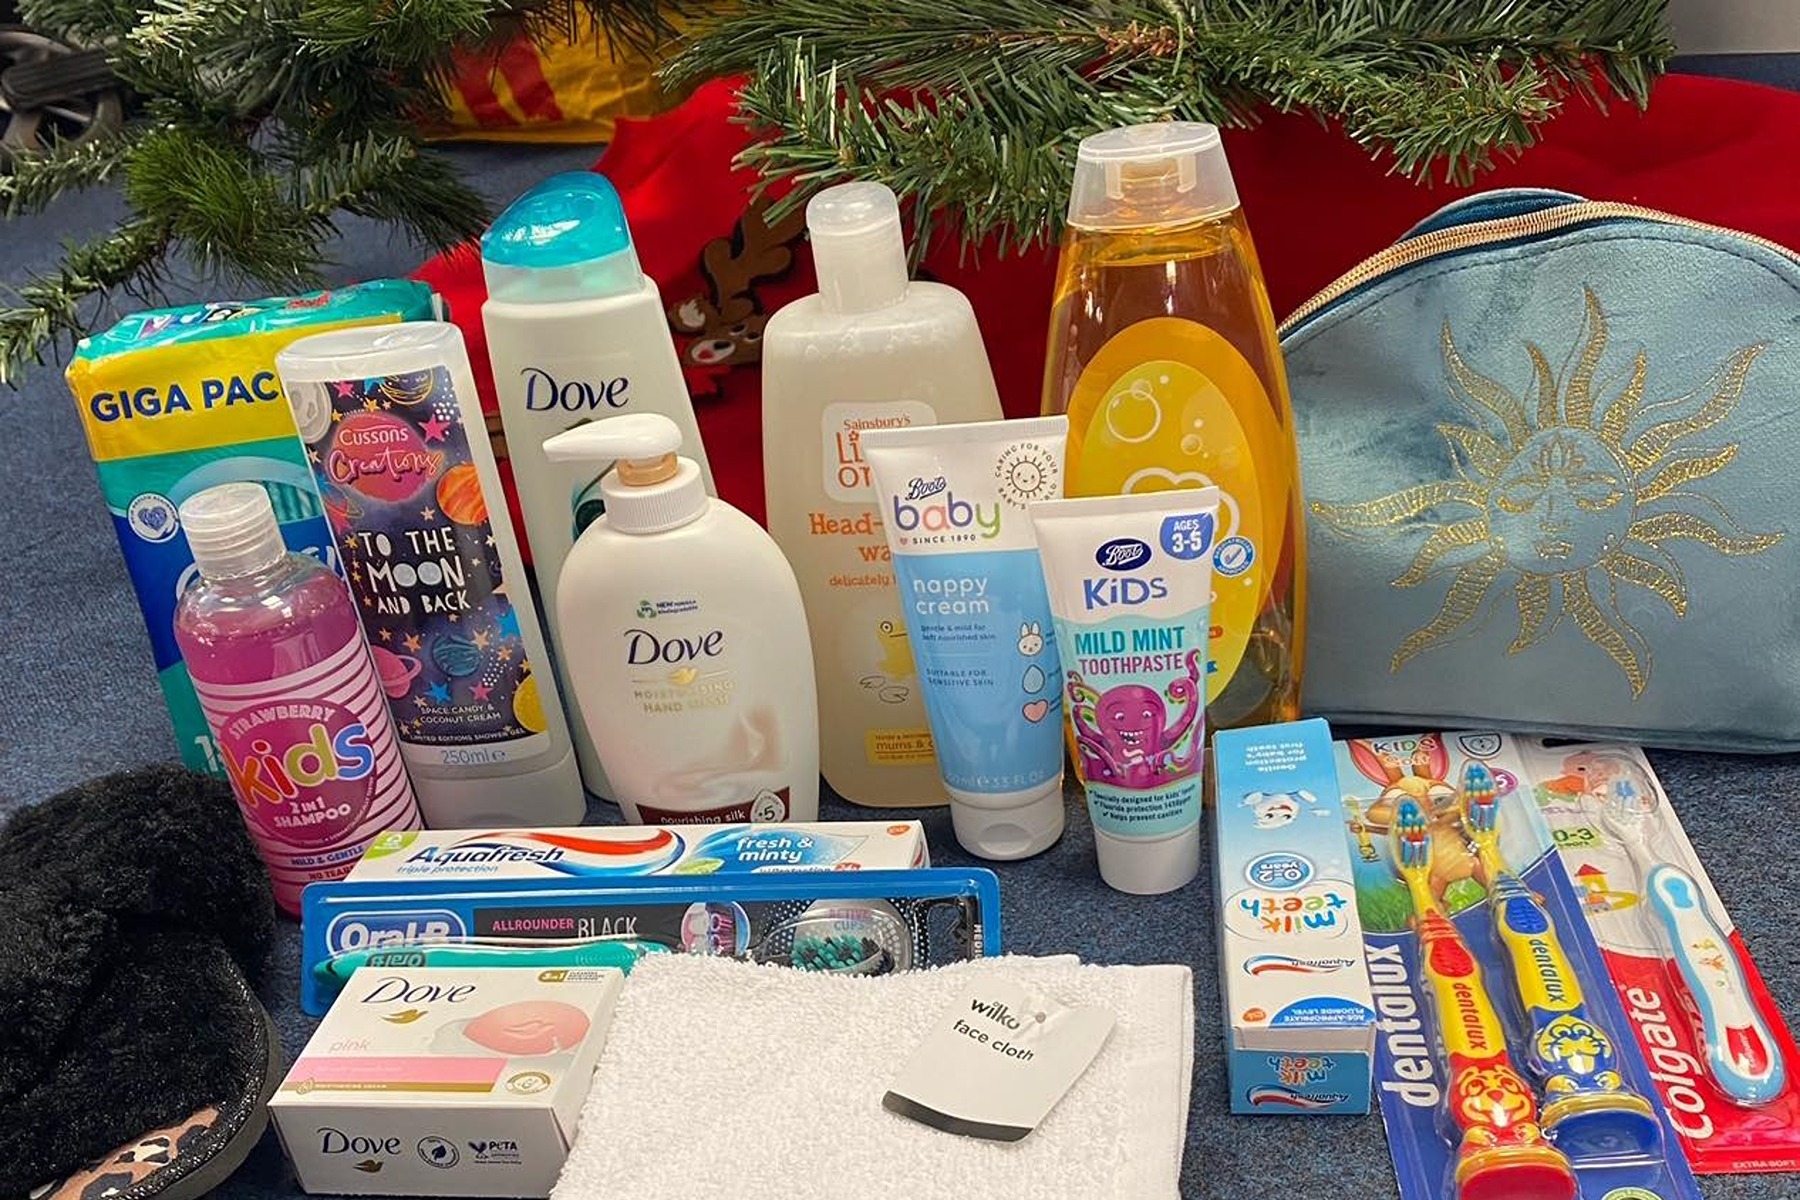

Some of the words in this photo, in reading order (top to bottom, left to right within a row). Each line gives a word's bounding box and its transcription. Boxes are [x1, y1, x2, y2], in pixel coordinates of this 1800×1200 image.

[90, 384, 192, 422] GIGA
[202, 371, 286, 409] PAC
[520, 367, 629, 411] Dove
[843, 413, 911, 431] Sainsbury's
[339, 426, 409, 446] Cussons
[329, 446, 445, 483] Creations
[994, 444, 1017, 478] CARING
[1020, 443, 1039, 451] FOR
[1042, 449, 1058, 474] YOUR
[905, 476, 947, 501] Boots
[808, 512, 883, 535] Head-
[893, 490, 1001, 539] baby
[1173, 519, 1200, 532] AGES
[358, 532, 392, 557] TO
[405, 526, 456, 555] THE
[913, 535, 945, 545] SINCE
[951, 534, 976, 543] 1890
[1172, 531, 1202, 553] 3-5
[859, 544, 890, 562] wa
[1102, 544, 1144, 567] Boots
[365, 555, 466, 593] MOON
[829, 574, 889, 587] delicately
[913, 577, 988, 598] nappy
[377, 597, 411, 615] AND
[421, 590, 471, 613] BACK
[916, 600, 990, 616] cream
[623, 628, 724, 665] Dove
[1074, 631, 1126, 656] MILD
[1132, 626, 1186, 653] MINT
[926, 668, 966, 677] SUITABLE
[968, 669, 987, 677] FOR
[1078, 653, 1184, 676] TOOTHPASTE
[928, 678, 970, 687] SENSITIVE
[973, 679, 995, 687] SKIN
[420, 715, 464, 725] COCONUT
[466, 712, 502, 723] CREAM
[421, 706, 449, 715] SPACE
[451, 705, 484, 715] CANDY
[487, 704, 495, 712] &
[643, 702, 682, 714] HAND
[228, 704, 337, 740] STRAWBERRY
[876, 741, 912, 750] mums
[1373, 739, 1437, 752] KIDS
[221, 722, 376, 808] kids
[442, 750, 491, 765] 250ml
[290, 801, 301, 815] 2
[301, 800, 317, 813] IN
[1121, 795, 1153, 804] designed
[274, 803, 351, 828] SHAMPOO
[660, 812, 722, 824] nourishing
[725, 808, 746, 821] silk
[736, 836, 791, 851] fresh
[796, 836, 814, 848] &
[1552, 827, 1595, 842] 0-3
[291, 855, 315, 867] MILD
[317, 854, 326, 864] &
[327, 845, 365, 863] GENTLE
[407, 845, 567, 867] Aquafresh
[738, 850, 803, 863] minty
[1260, 860, 1300, 870] years
[309, 872, 324, 881] NO
[325, 865, 356, 879] TEAR
[397, 864, 431, 875] triple
[432, 863, 500, 875] protection
[1257, 868, 1301, 882] 0-2
[1240, 892, 1348, 917] teeth
[492, 918, 576, 932] ALLROUNDER
[577, 916, 639, 940] BLACK
[833, 919, 864, 931] CUPS
[1260, 910, 1336, 934] milk
[340, 921, 450, 950] Oral-B
[973, 923, 984, 960] MEDI
[1529, 938, 1567, 1003] dentalux
[361, 976, 477, 1004] Dove
[970, 999, 1020, 1030] wilko
[1364, 943, 1440, 1107] dentalux
[1453, 981, 1488, 1050] dentalux
[328, 1035, 372, 1054] pink
[953, 1019, 989, 1043] face
[992, 1041, 1034, 1061] cloth
[1267, 1056, 1335, 1071] teeth
[1626, 987, 1714, 1139] Colgate
[1280, 1069, 1326, 1085] milk
[316, 1127, 402, 1155] Dove
